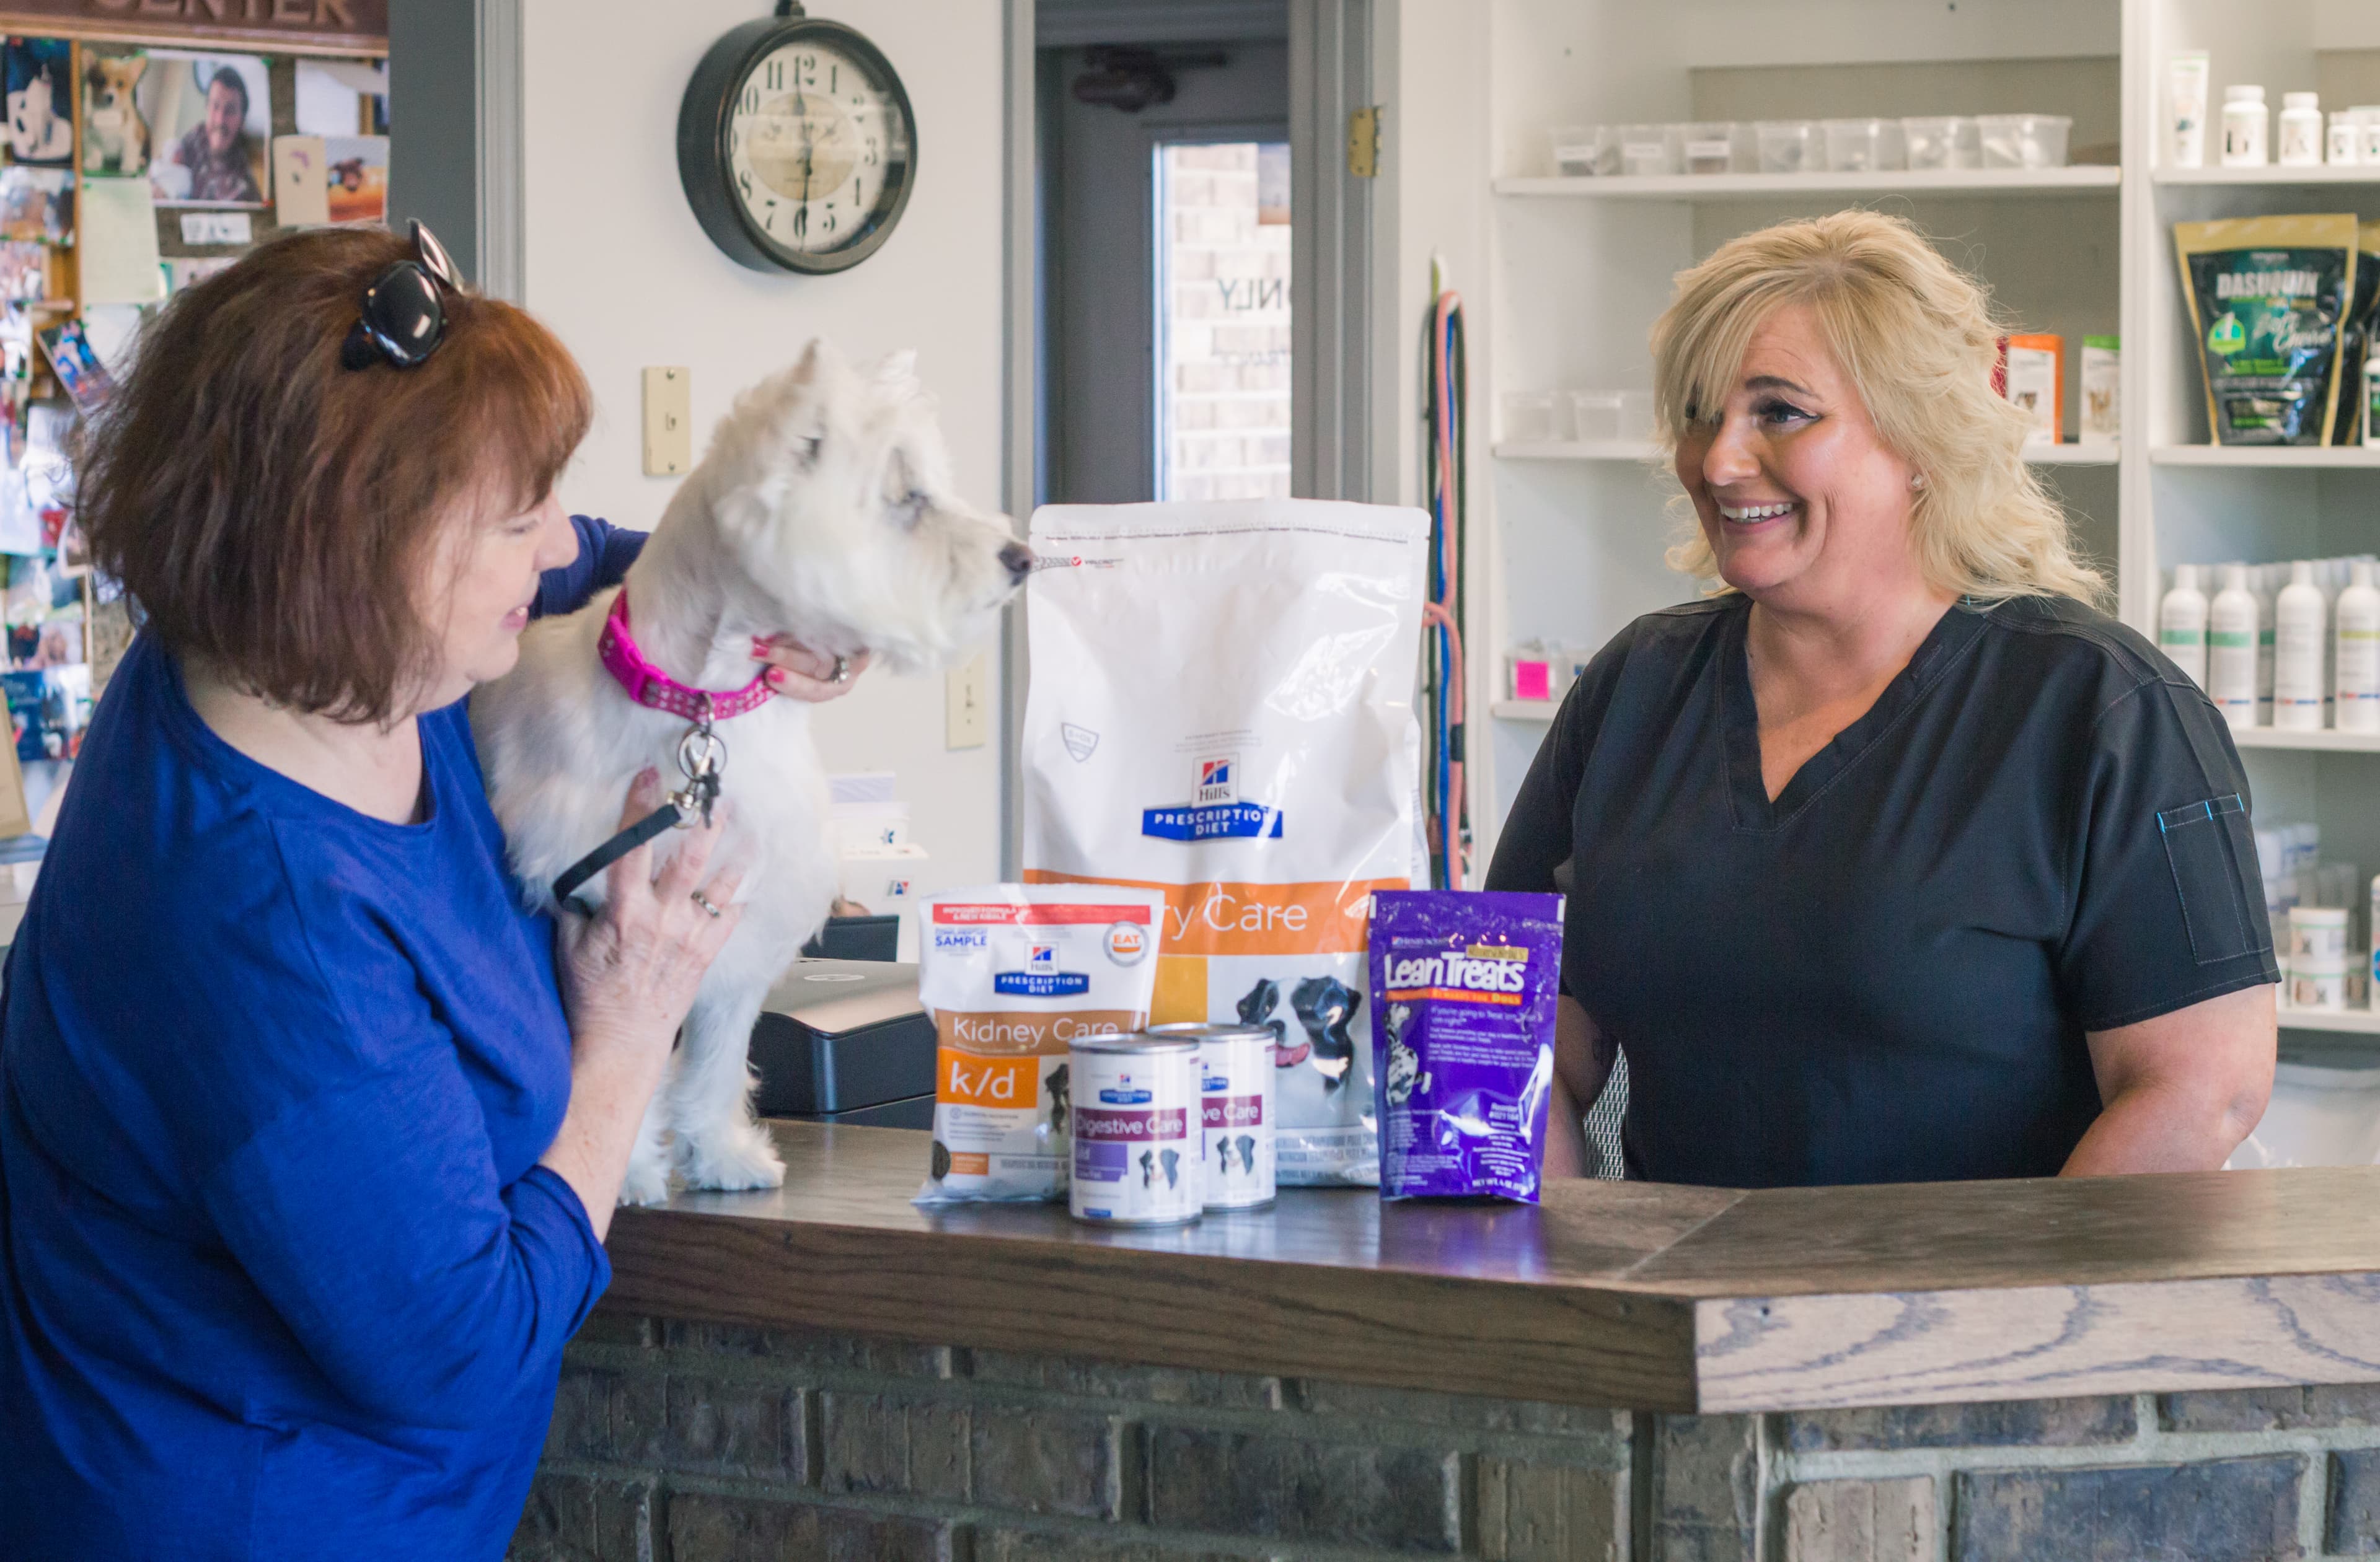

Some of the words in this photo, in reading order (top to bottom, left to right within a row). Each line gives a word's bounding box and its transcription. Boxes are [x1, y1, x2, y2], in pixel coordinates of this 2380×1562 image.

[767, 61, 783, 90] 11
[795, 55, 816, 86] 12
[1155, 807, 1274, 825] PRESCRIPTIO
[1196, 822, 1230, 835] DIET
[1207, 894, 1308, 931] Care
[935, 935, 987, 947] SAMPLE
[1113, 934, 1140, 944] EAT
[1001, 976, 1083, 986] PRESCRIPTION
[1028, 985, 1054, 993] DIET
[954, 1016, 1046, 1048] Kidney
[1053, 1017, 1119, 1041] Care
[950, 1061, 1015, 1099] k/d
[1223, 1103, 1259, 1121] Care
[1146, 1116, 1183, 1135] Care
